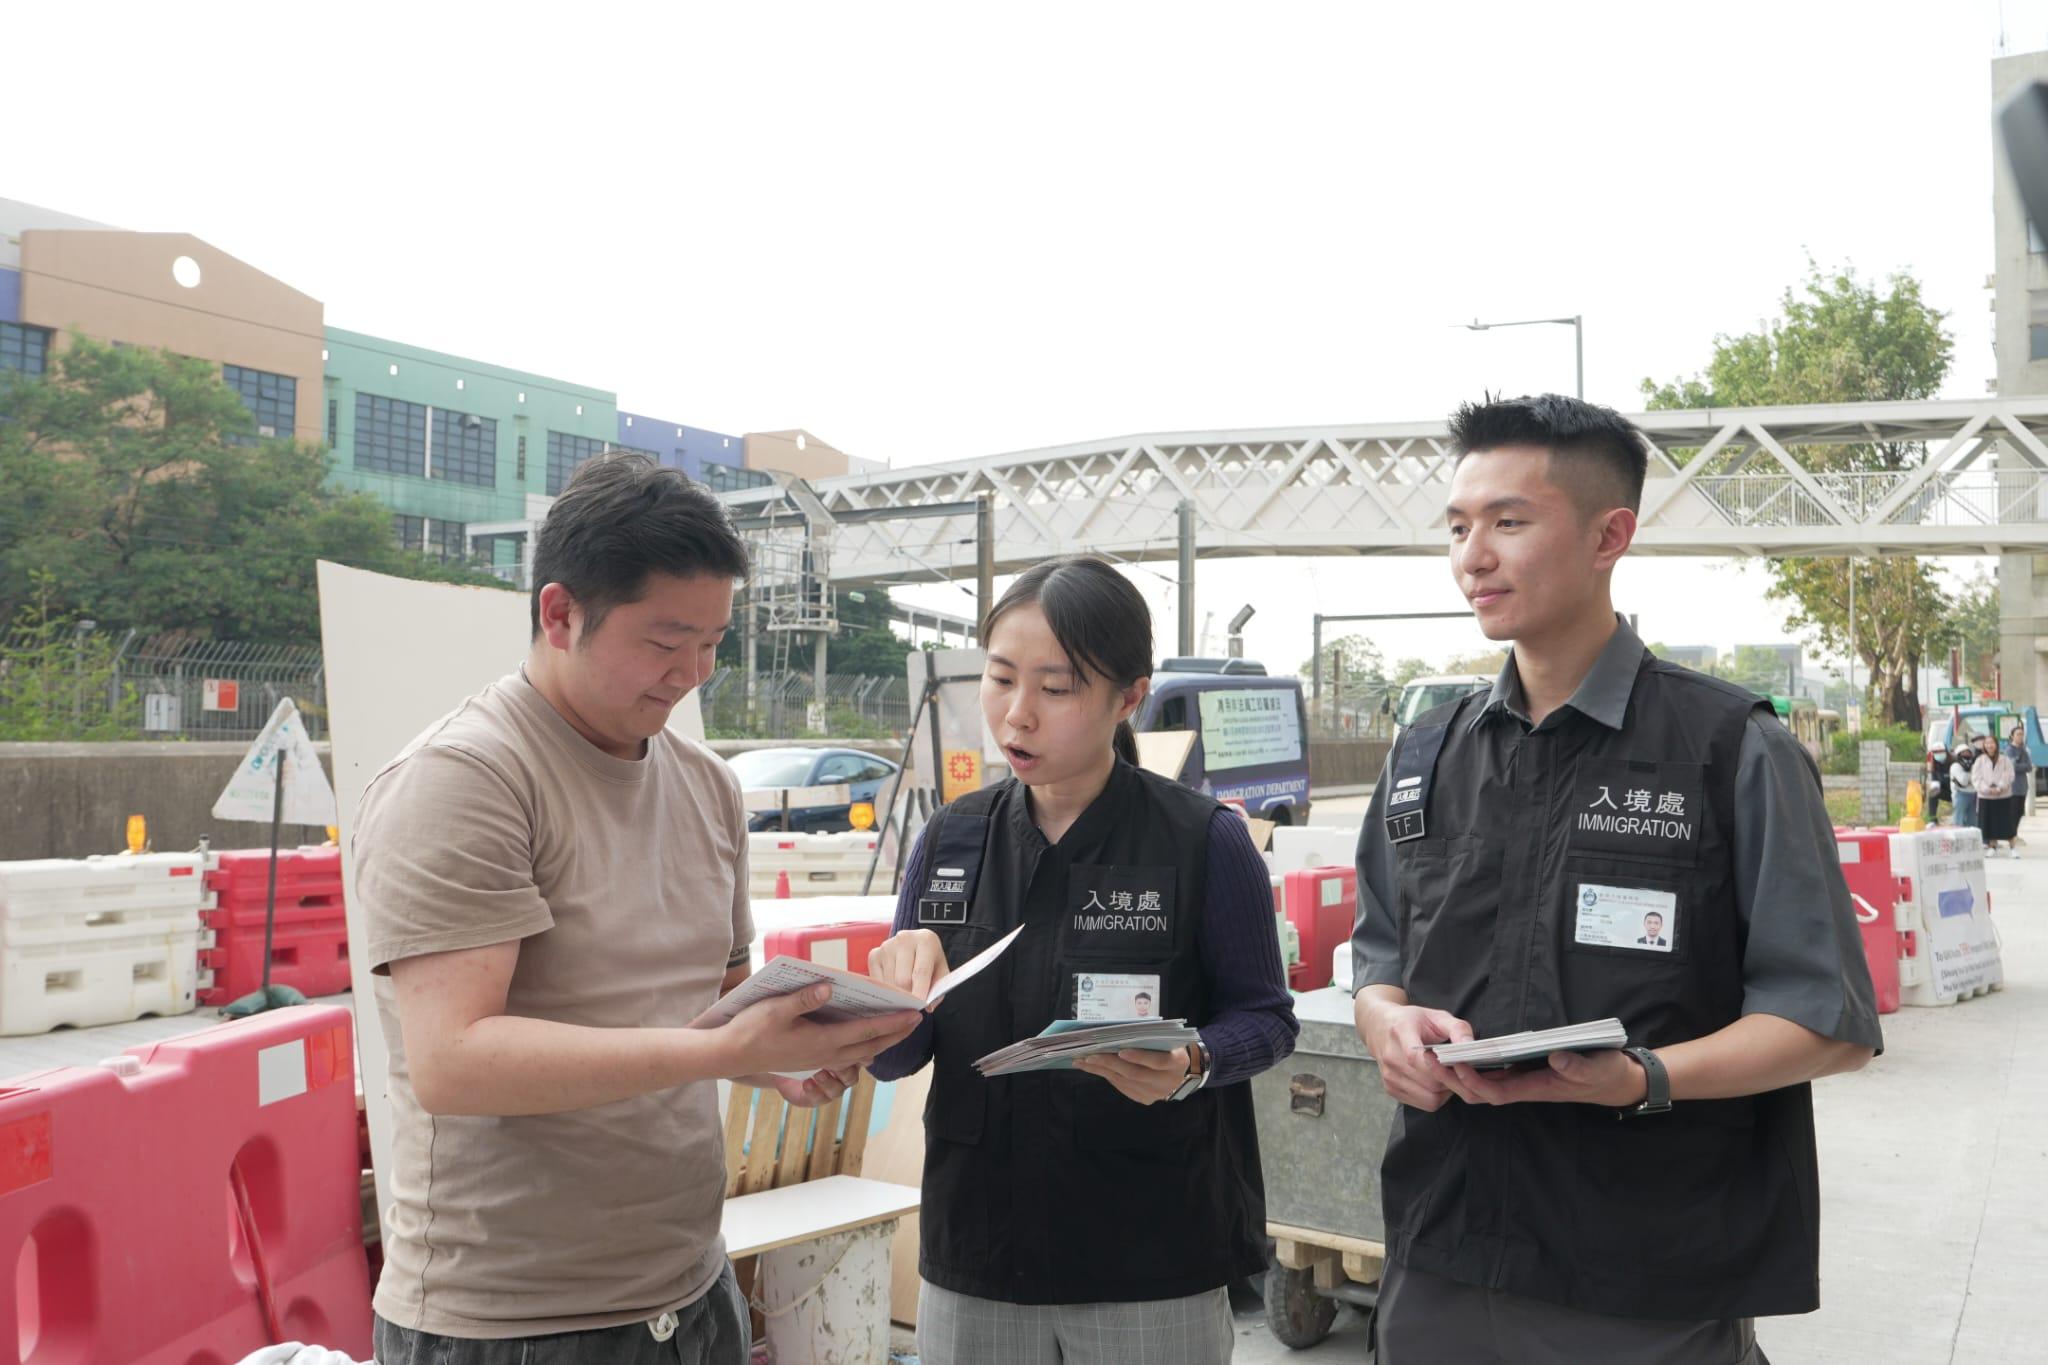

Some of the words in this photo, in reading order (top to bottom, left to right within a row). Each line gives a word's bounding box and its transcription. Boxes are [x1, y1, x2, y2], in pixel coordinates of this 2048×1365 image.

[1216, 785, 1265, 799] IMMIGRATION
[1266, 779, 1305, 796] DEPARTMENT
[1589, 786, 1685, 816] 入境處
[1577, 812, 1692, 840] IMMIGRATION
[1082, 889, 1161, 911] 入境處
[1074, 914, 1167, 931] IMMIGRATION
